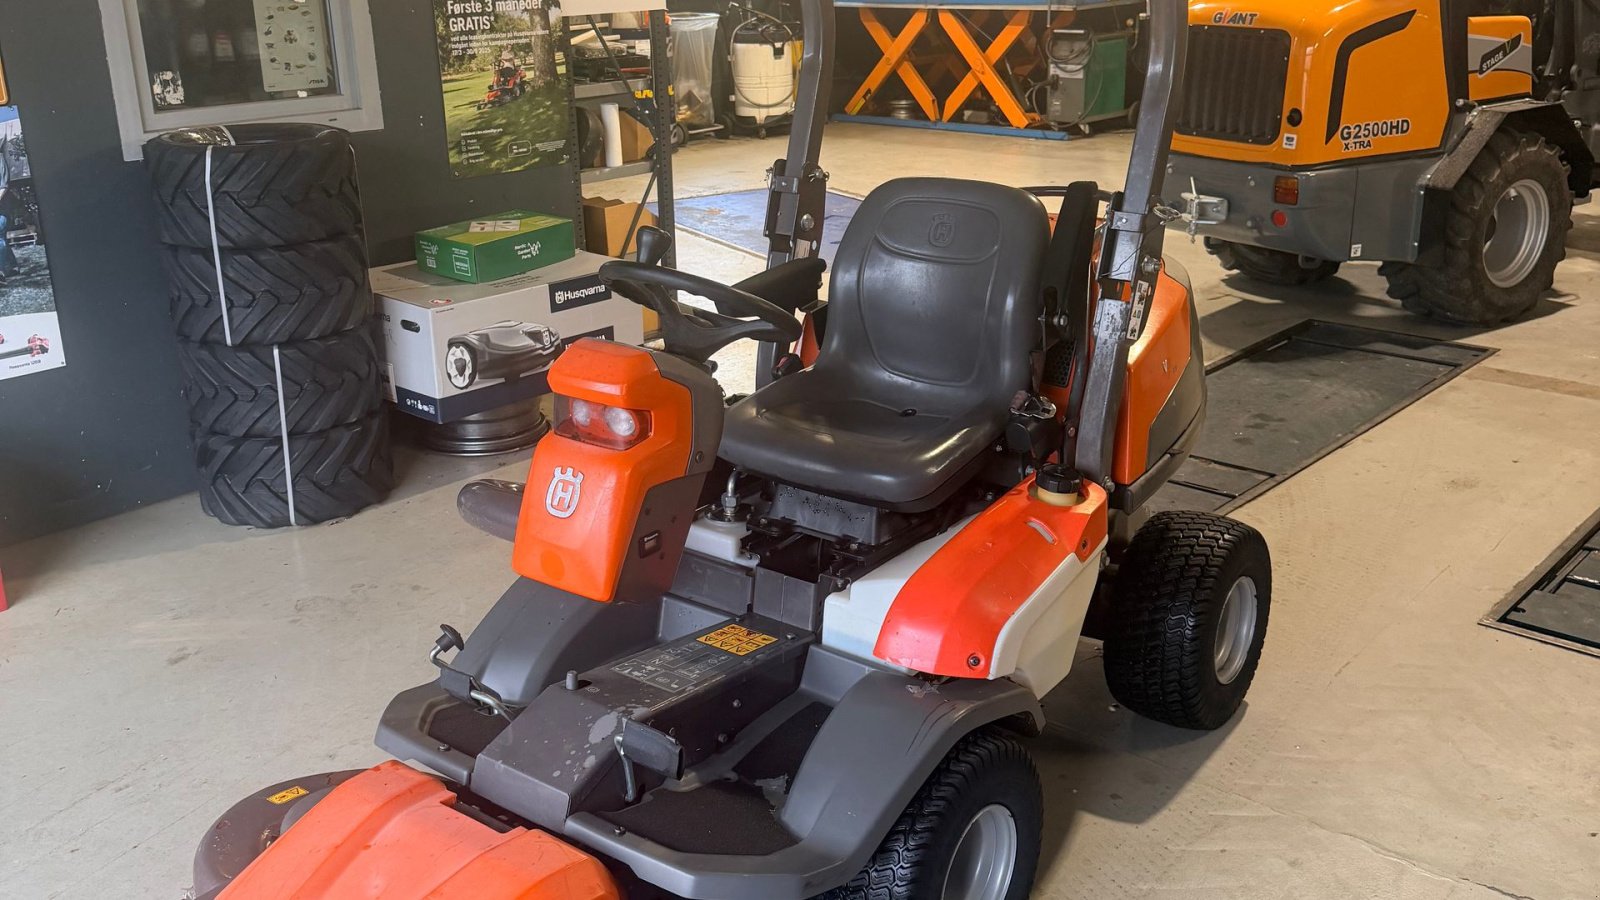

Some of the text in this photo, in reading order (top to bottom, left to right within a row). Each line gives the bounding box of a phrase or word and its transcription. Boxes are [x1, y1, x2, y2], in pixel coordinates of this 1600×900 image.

[447, 0, 483, 15] Første
[485, 0, 493, 12] 3
[1213, 9, 1258, 26] GIANT
[1482, 50, 1504, 72] STAGE
[1339, 118, 1411, 141] G2500HD
[1343, 140, 1372, 152] X-TRA
[564, 284, 606, 301] Husqvarna
